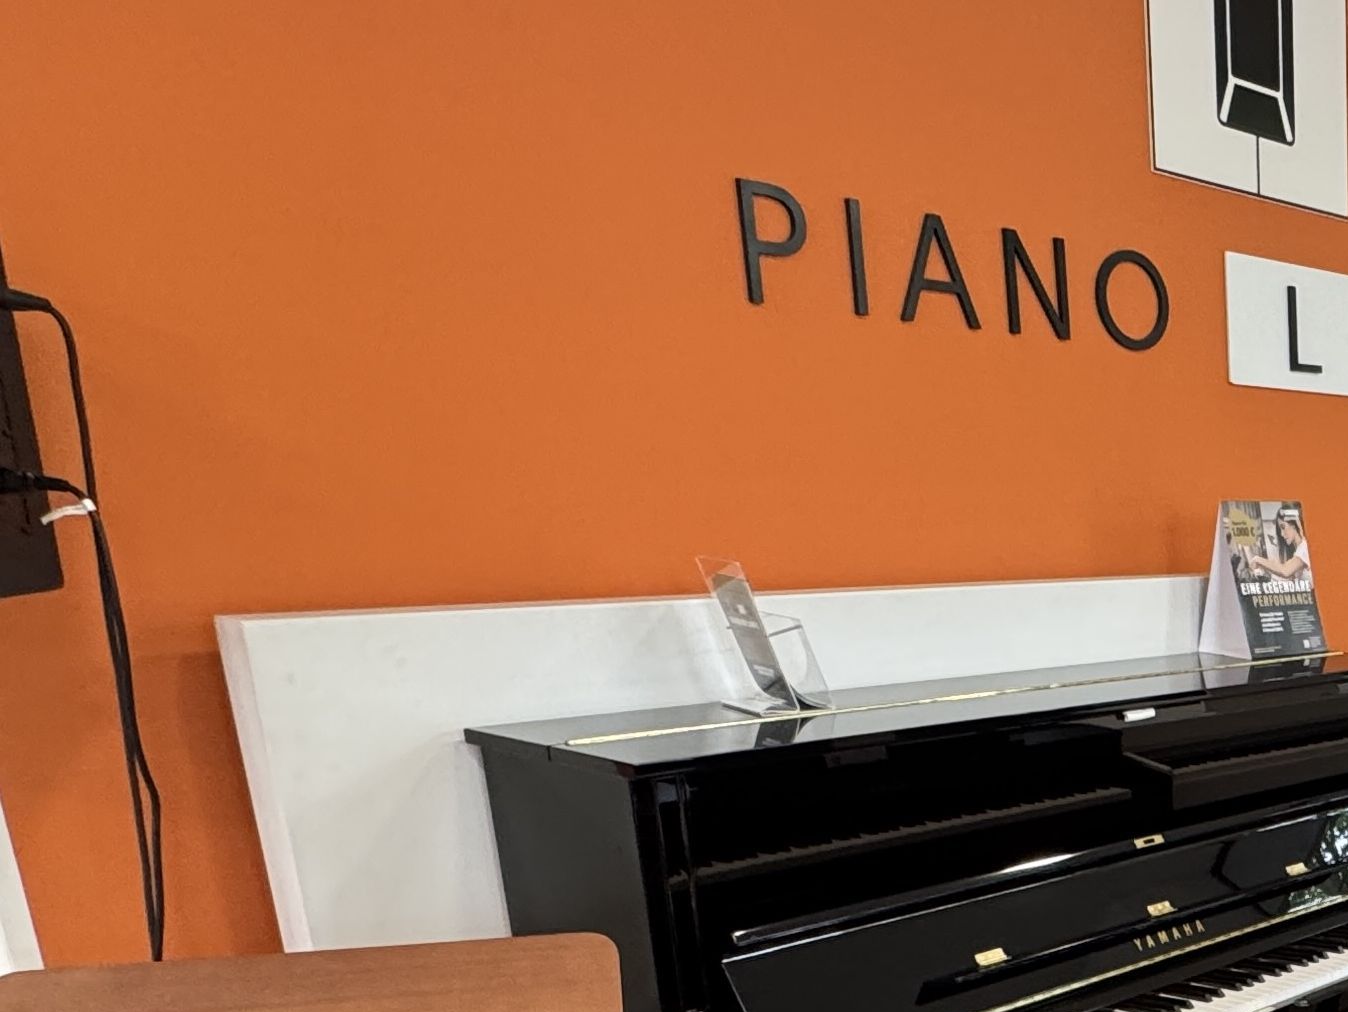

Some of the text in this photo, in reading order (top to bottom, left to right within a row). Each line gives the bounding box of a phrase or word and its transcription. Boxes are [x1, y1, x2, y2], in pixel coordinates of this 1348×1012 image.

[735, 177, 1170, 352] PIANO
[1240, 582, 1262, 596] EINE
[1251, 592, 1314, 608] PERFORMANCE
[1133, 919, 1206, 952] YAMAHA
